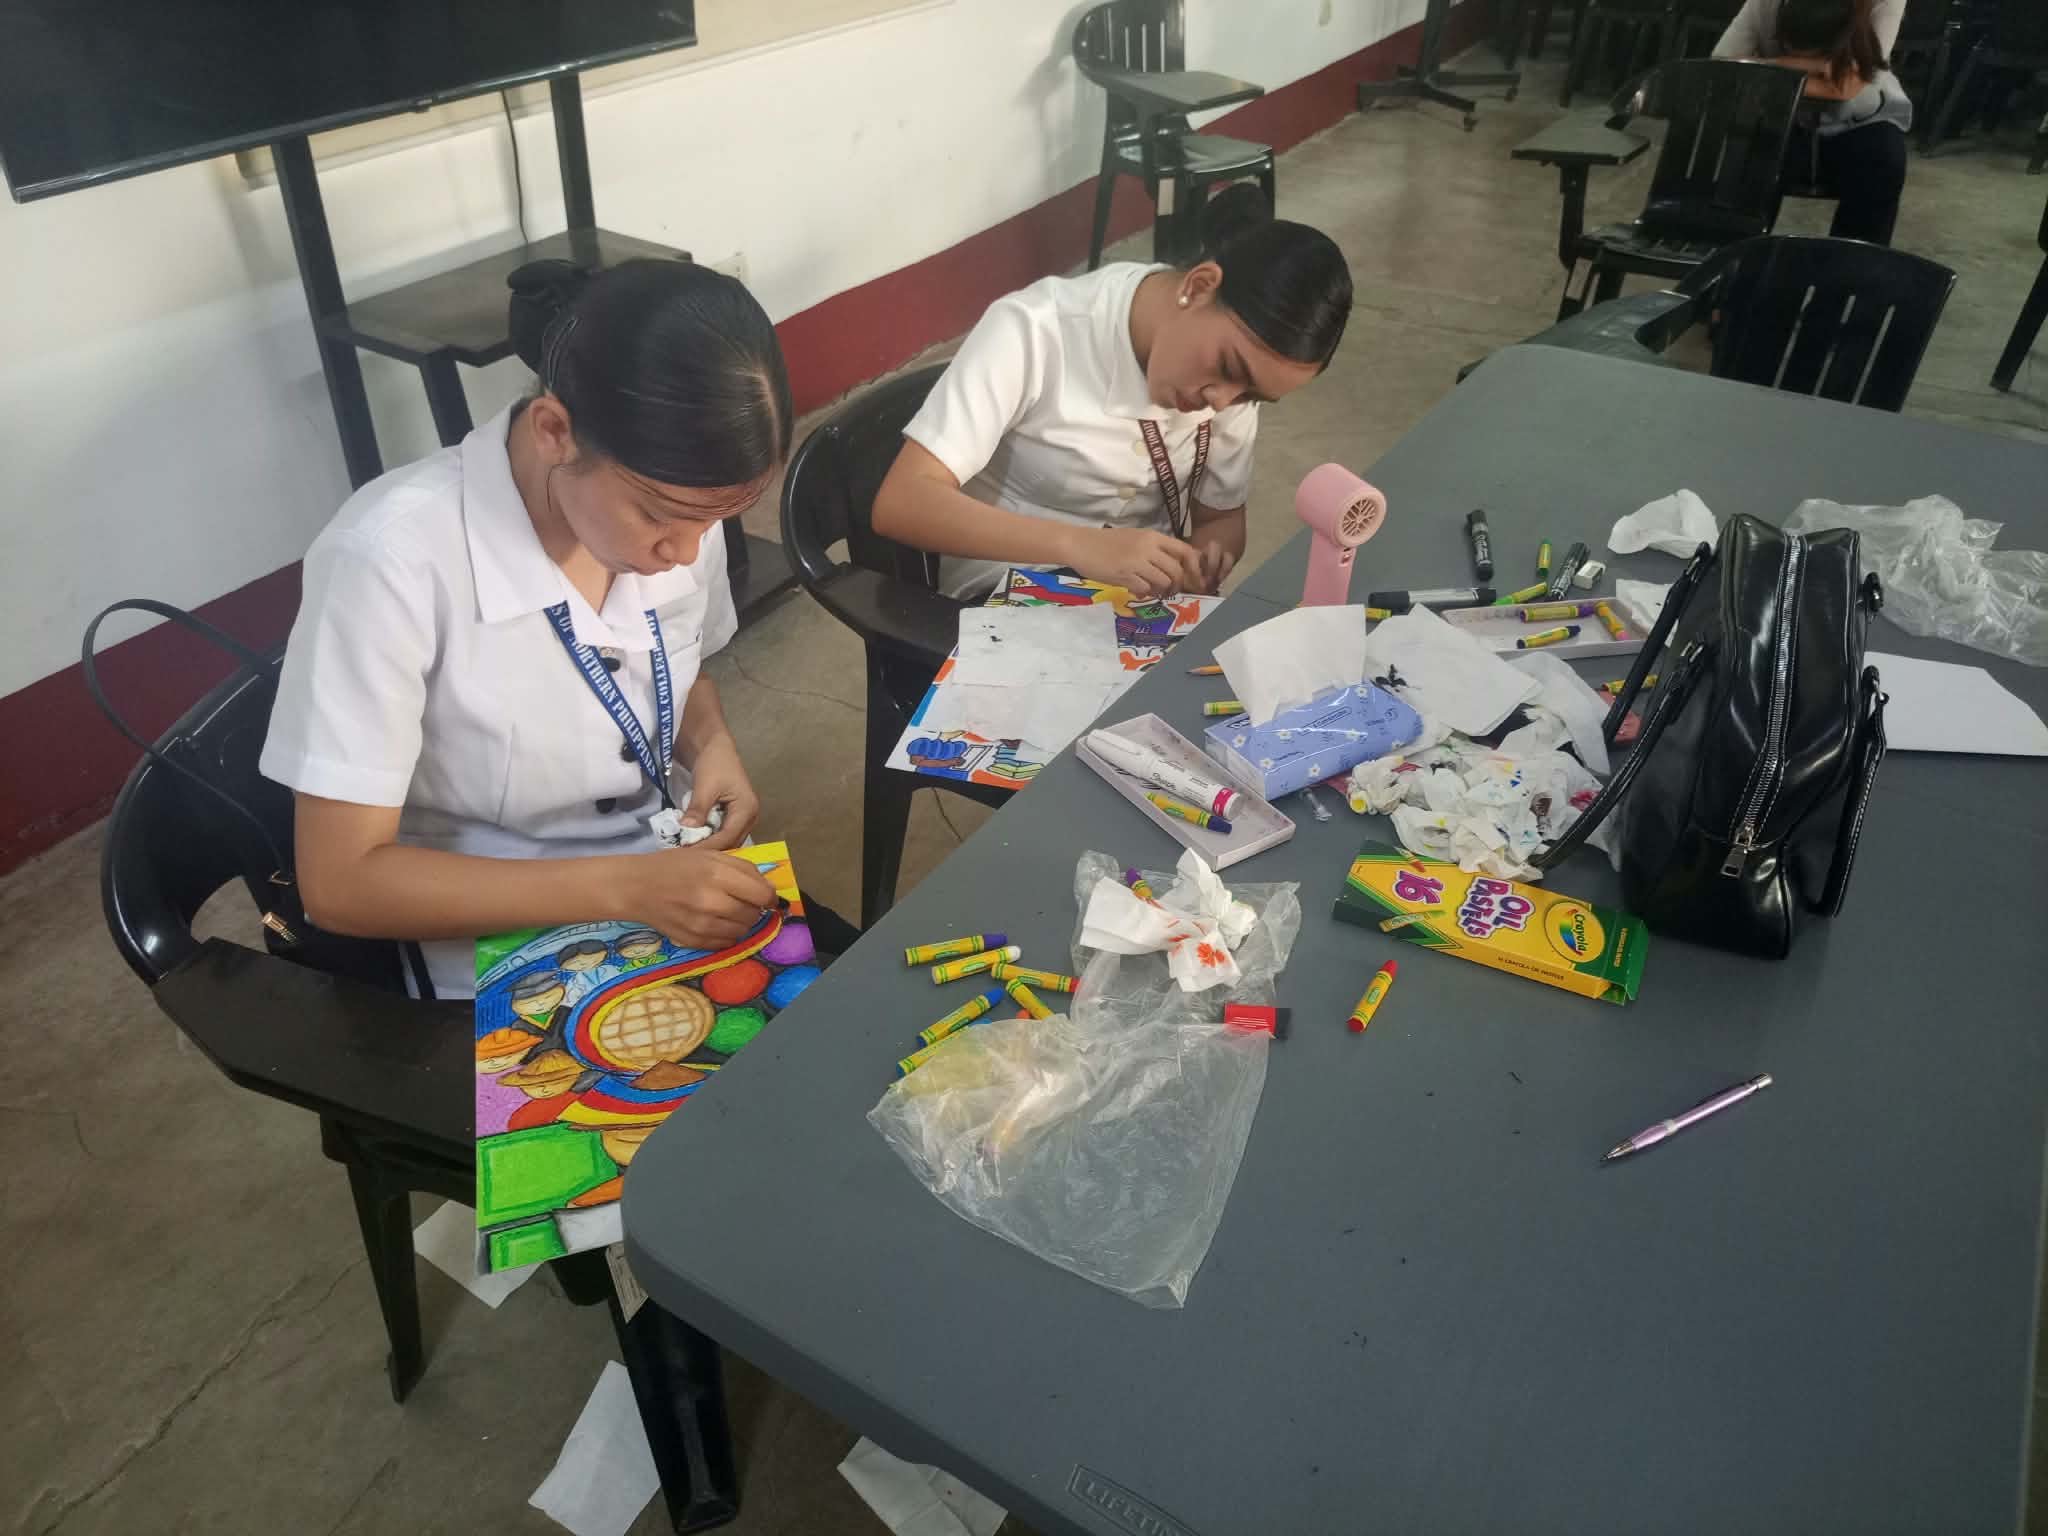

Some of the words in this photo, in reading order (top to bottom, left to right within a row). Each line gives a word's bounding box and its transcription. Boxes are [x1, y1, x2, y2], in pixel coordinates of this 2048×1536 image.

[1151, 447, 1165, 459] OF
[612, 700, 656, 777] PHILIPPINES
[1394, 870, 1444, 904] 16
[1460, 878, 1509, 936] PASTELS
[1492, 896, 1532, 929] OIL
[1573, 911, 1588, 952] Crayola
